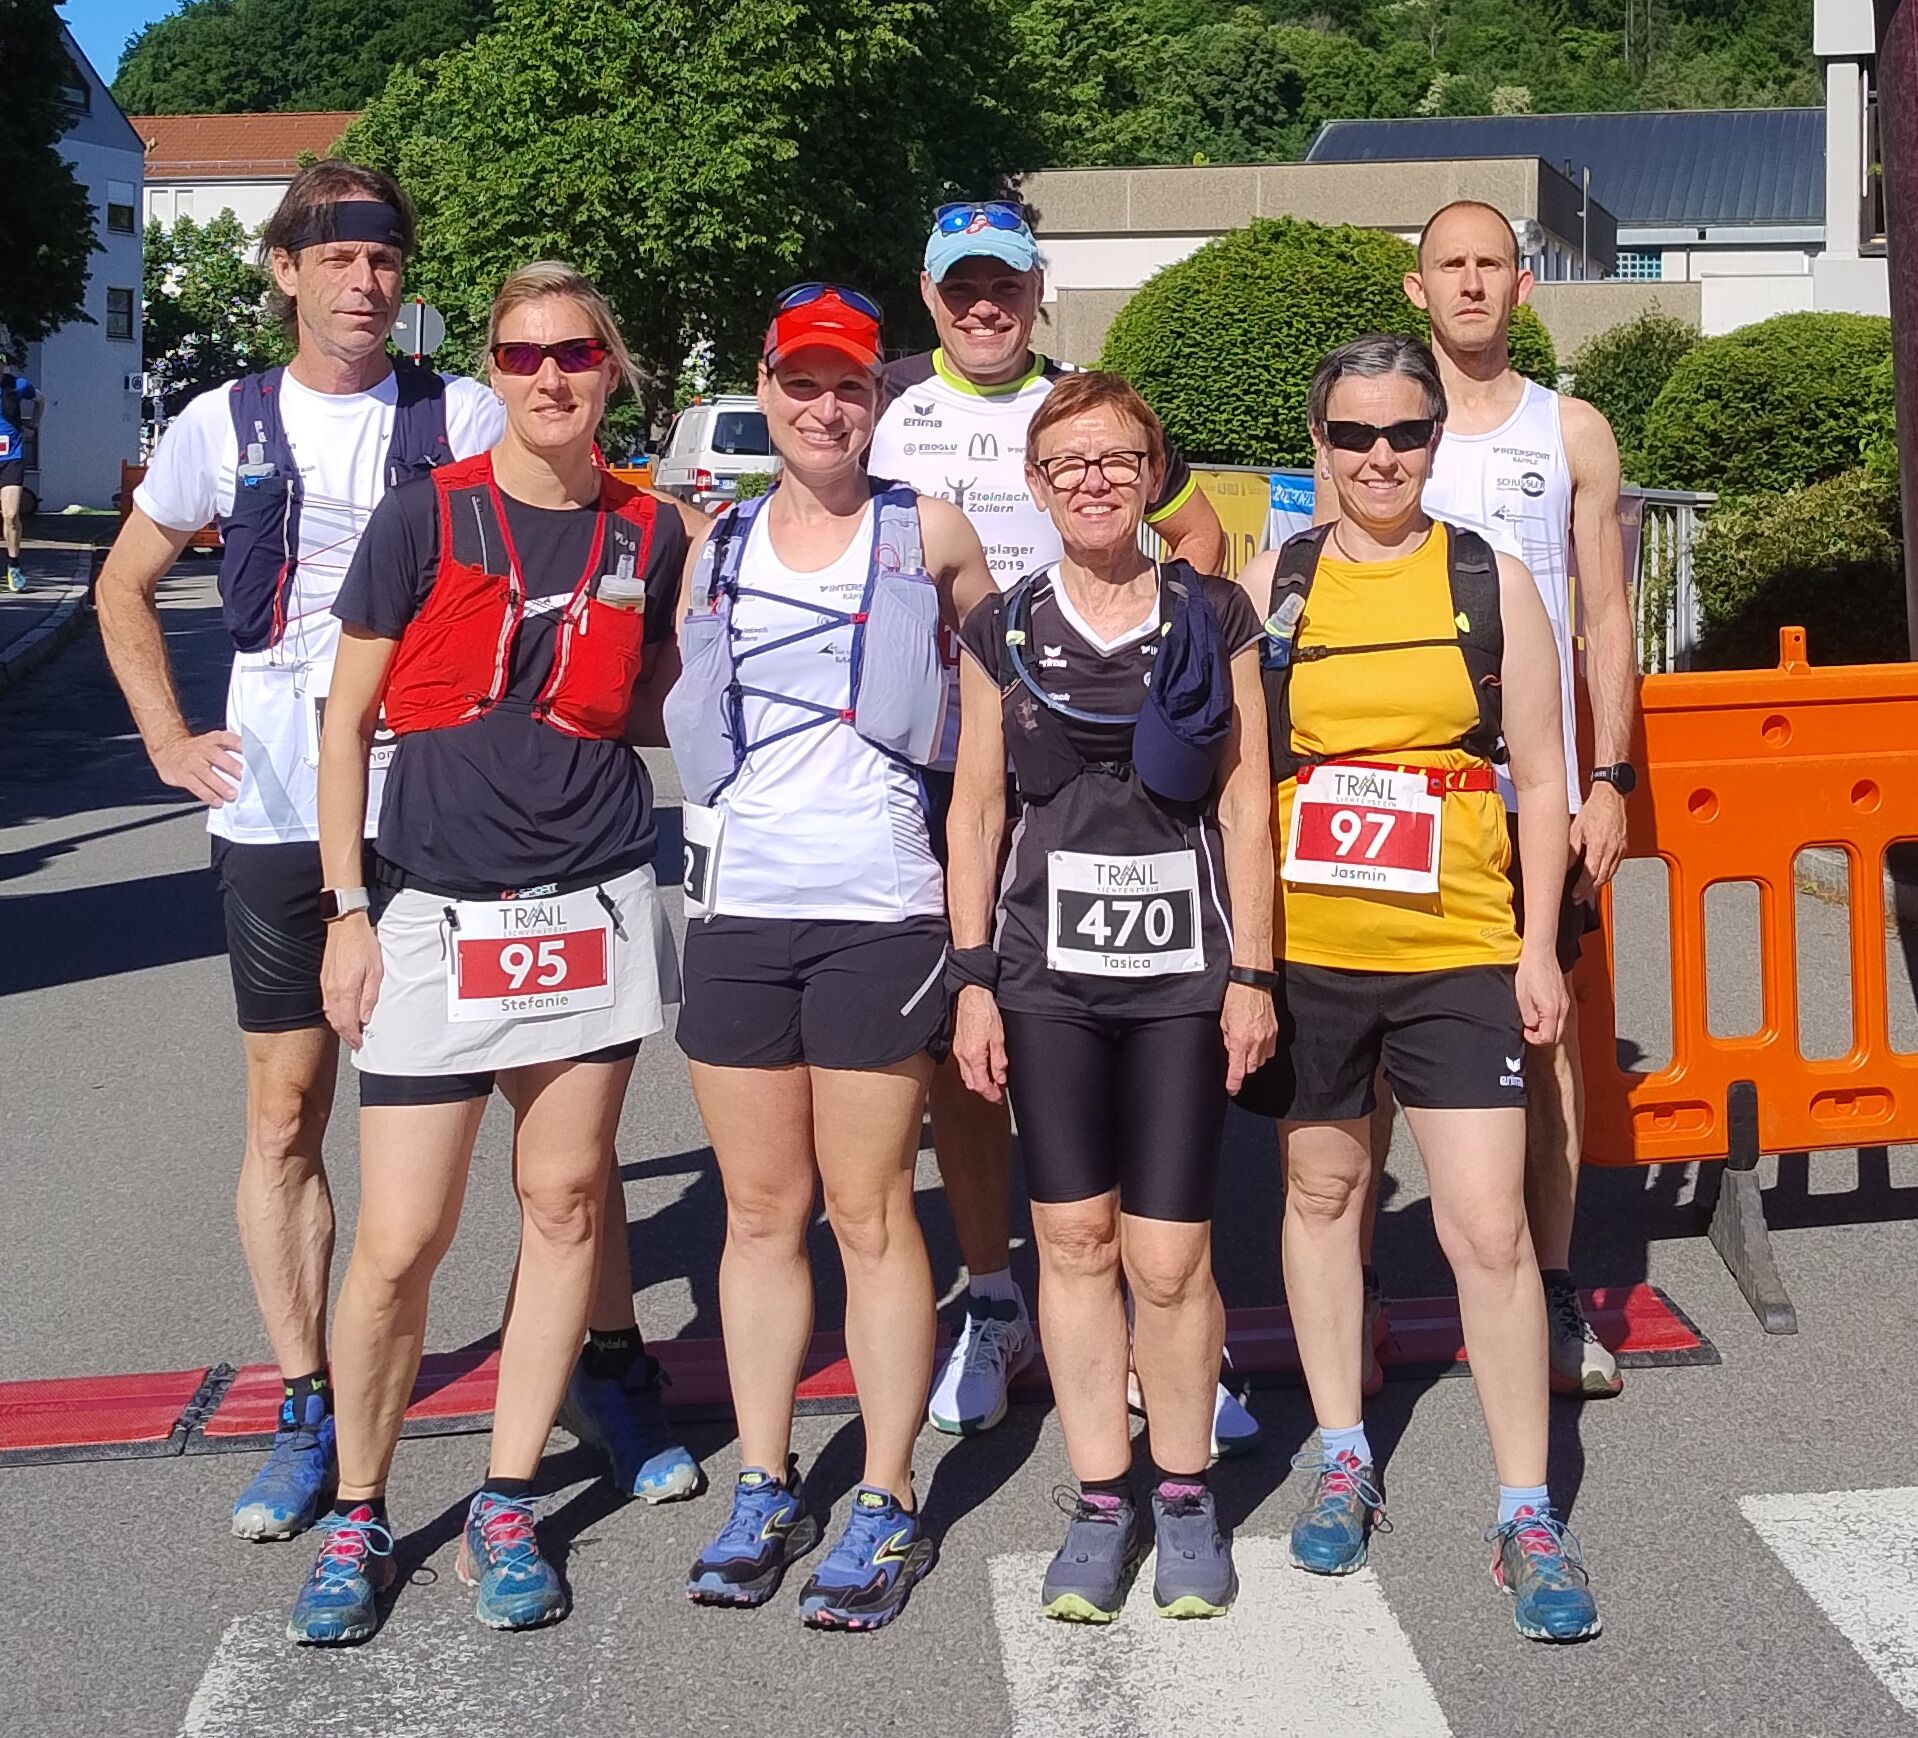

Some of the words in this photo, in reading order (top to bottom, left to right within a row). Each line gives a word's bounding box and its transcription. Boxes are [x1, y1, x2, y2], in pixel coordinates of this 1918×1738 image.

[903, 418, 942, 428] erima
[968, 491, 1030, 501] Steinlach
[968, 503, 1014, 513] Zollern
[989, 560, 1025, 571] 2019
[1335, 772, 1397, 801] TRAIL
[1330, 809, 1396, 859] 97
[1093, 860, 1159, 887] TRAIL
[1331, 865, 1387, 882] Jasmin
[498, 901, 567, 930] TRAIL
[1076, 899, 1174, 947] 470
[500, 940, 567, 990] 95
[1102, 955, 1151, 969] Tasica
[501, 994, 569, 1012] Stefanie
